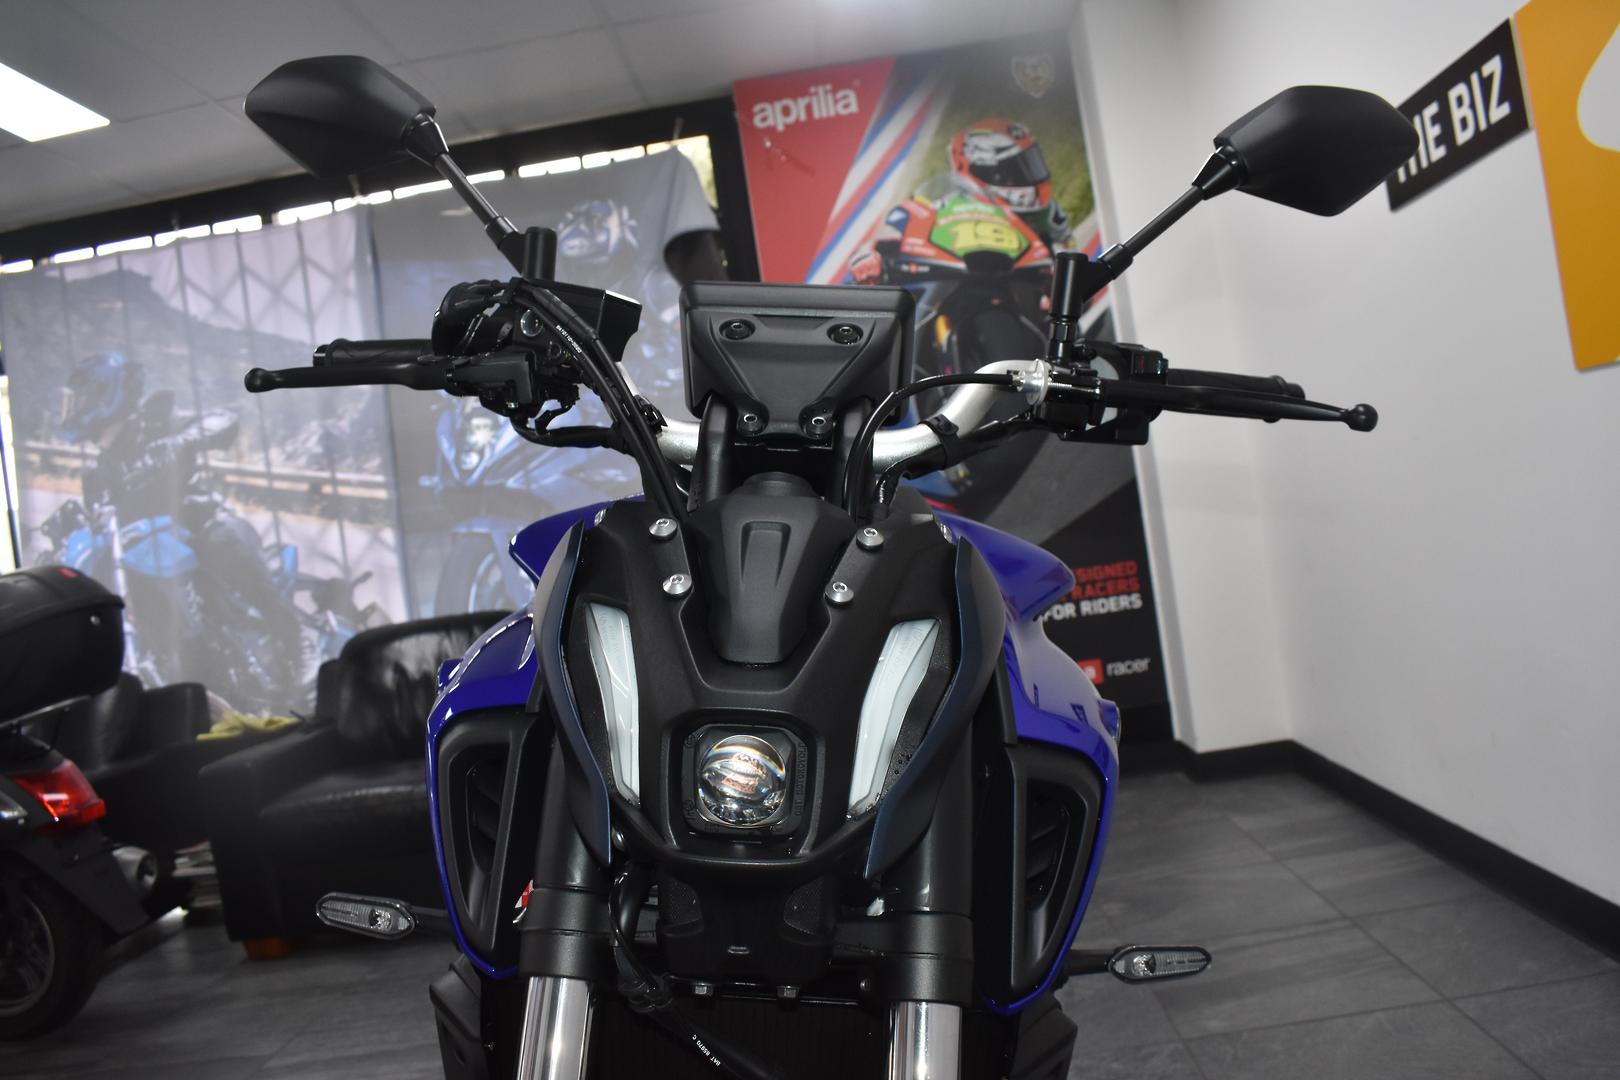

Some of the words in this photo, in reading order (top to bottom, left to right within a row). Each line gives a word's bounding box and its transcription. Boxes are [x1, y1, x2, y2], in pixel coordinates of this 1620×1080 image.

[752, 83, 858, 132] aprilia
[1397, 100, 1448, 183] HE
[1447, 53, 1510, 146] BIZ
[1080, 593, 1142, 616] RIDERS
[1106, 658, 1150, 677] racer
